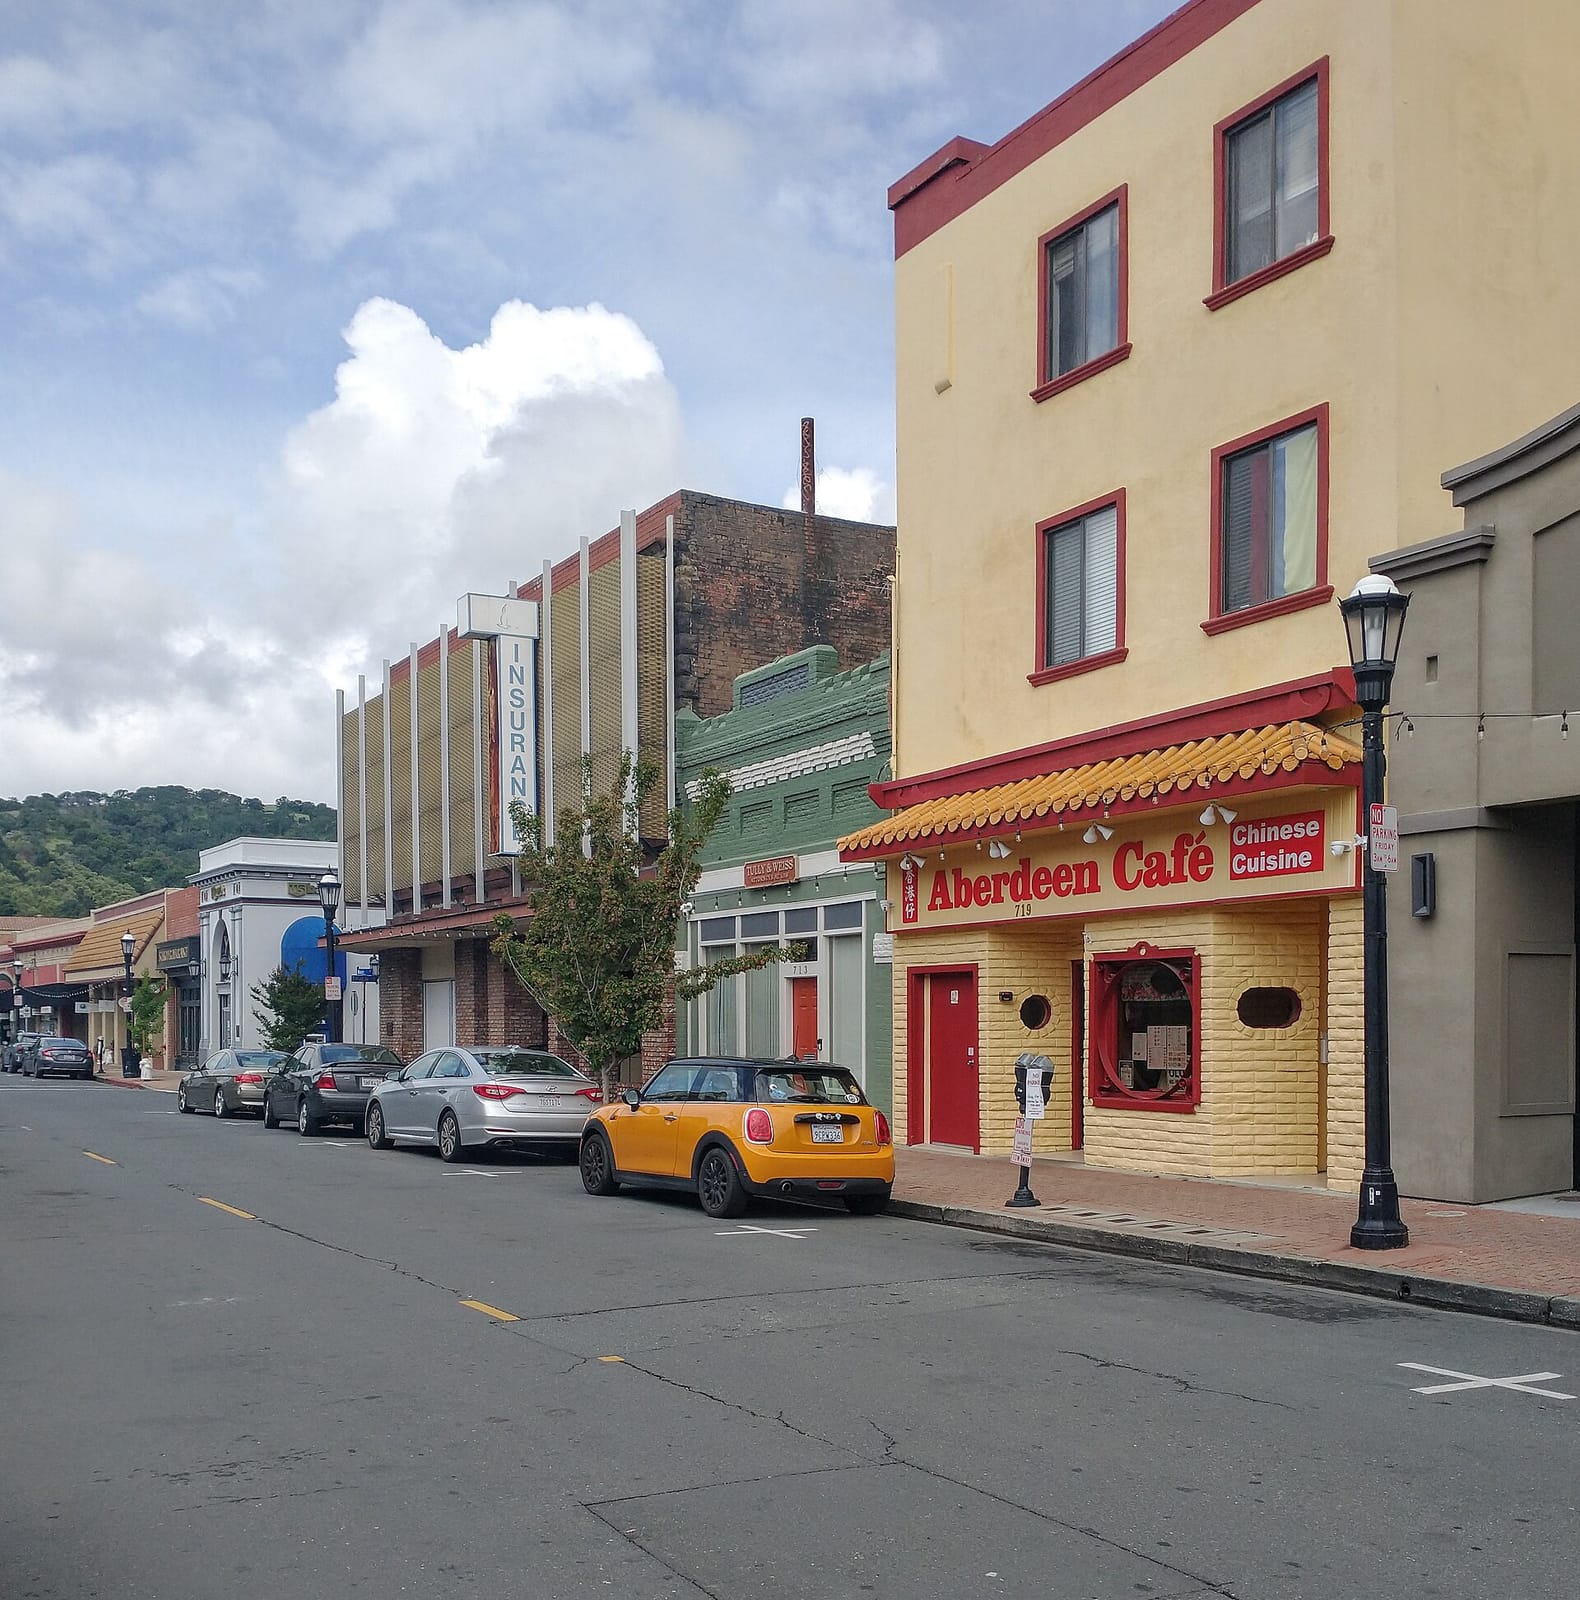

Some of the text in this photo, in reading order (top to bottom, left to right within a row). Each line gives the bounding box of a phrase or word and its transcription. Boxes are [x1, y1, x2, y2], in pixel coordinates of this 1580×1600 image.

[1372, 809, 1382, 823] NO
[1232, 819, 1320, 847] Chinese
[1372, 827, 1397, 841] PARKING
[1375, 841, 1394, 851] FRIDAY
[746, 859, 794, 877] TULLY & WEISS
[1231, 848, 1313, 875] Cuisine
[928, 831, 1214, 912] Aberdeen Café
[1014, 903, 1032, 918] 719
[793, 965, 807, 975] 713
